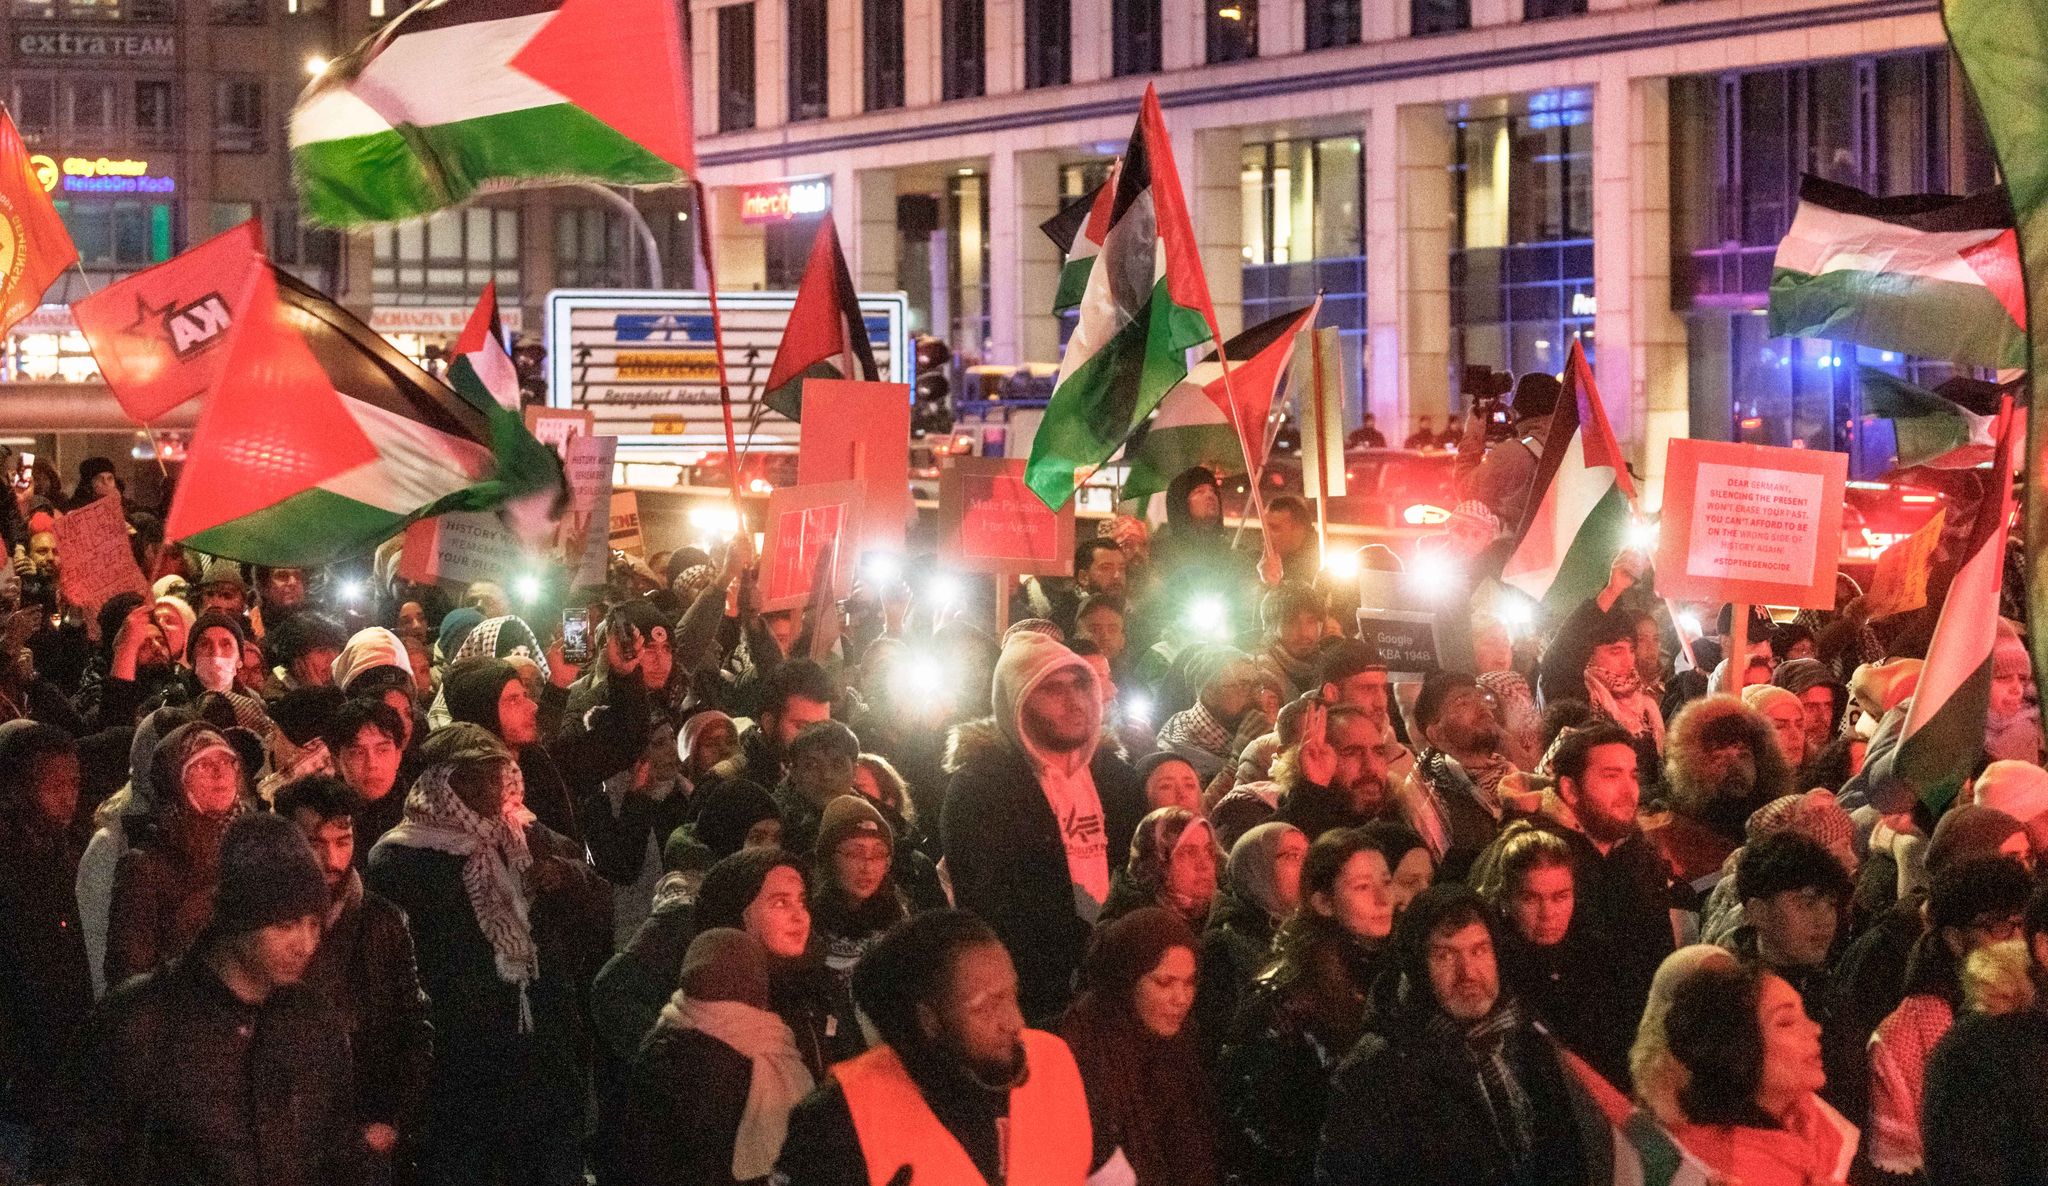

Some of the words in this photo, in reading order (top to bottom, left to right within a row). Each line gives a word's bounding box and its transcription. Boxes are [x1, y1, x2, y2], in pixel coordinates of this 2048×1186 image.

[19, 33, 107, 55] extra
[111, 36, 174, 56] TEAM
[678, 388, 721, 403] Harbur
[1728, 478, 1749, 488] DEAR
[1751, 480, 1791, 492] GERMANY,
[1710, 489, 1753, 501] SILENCING
[1755, 493, 1771, 503] THE
[1773, 495, 1809, 506] PRESENT
[1706, 502, 1733, 512] WON'T
[1735, 504, 1761, 515] ERASE
[446, 521, 498, 540] HISTORY
[1705, 515, 1723, 525] YOU
[1725, 517, 1749, 527] CAN'T
[1750, 519, 1783, 530] AFFORD
[1784, 522, 1795, 531] TO
[1797, 522, 1809, 532] BE
[1708, 527, 1720, 536] ON
[1722, 529, 1738, 538] THE
[1739, 530, 1769, 541] WRONG
[1771, 533, 1790, 543] SIDE
[1720, 541, 1755, 551] HISTORY
[1713, 558, 1791, 572] #STOPTHEGENOCIDE
[1377, 631, 1413, 647] Google
[1404, 651, 1431, 661] 1948
